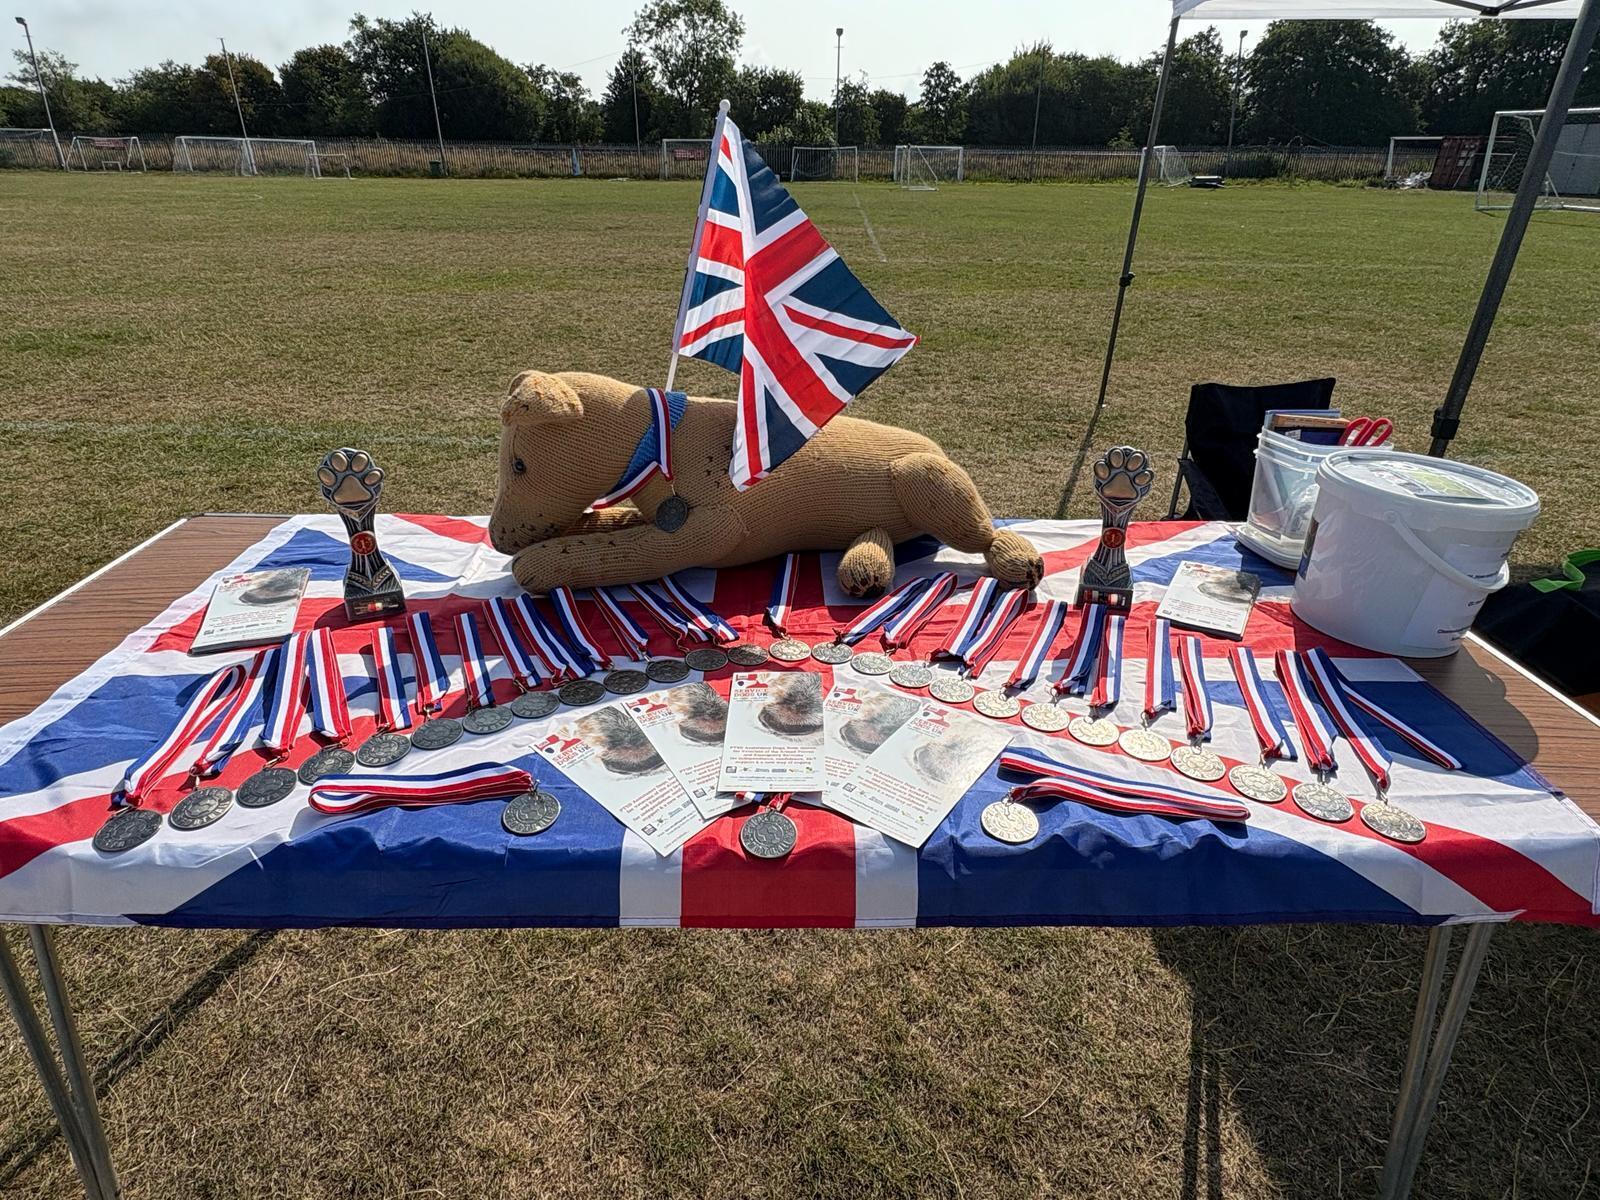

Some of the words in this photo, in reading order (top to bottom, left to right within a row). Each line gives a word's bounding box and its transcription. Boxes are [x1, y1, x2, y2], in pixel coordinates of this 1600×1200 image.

[552, 742, 588, 763] SERVICE
[556, 751, 579, 766] DOGS
[578, 745, 592, 754] UK
